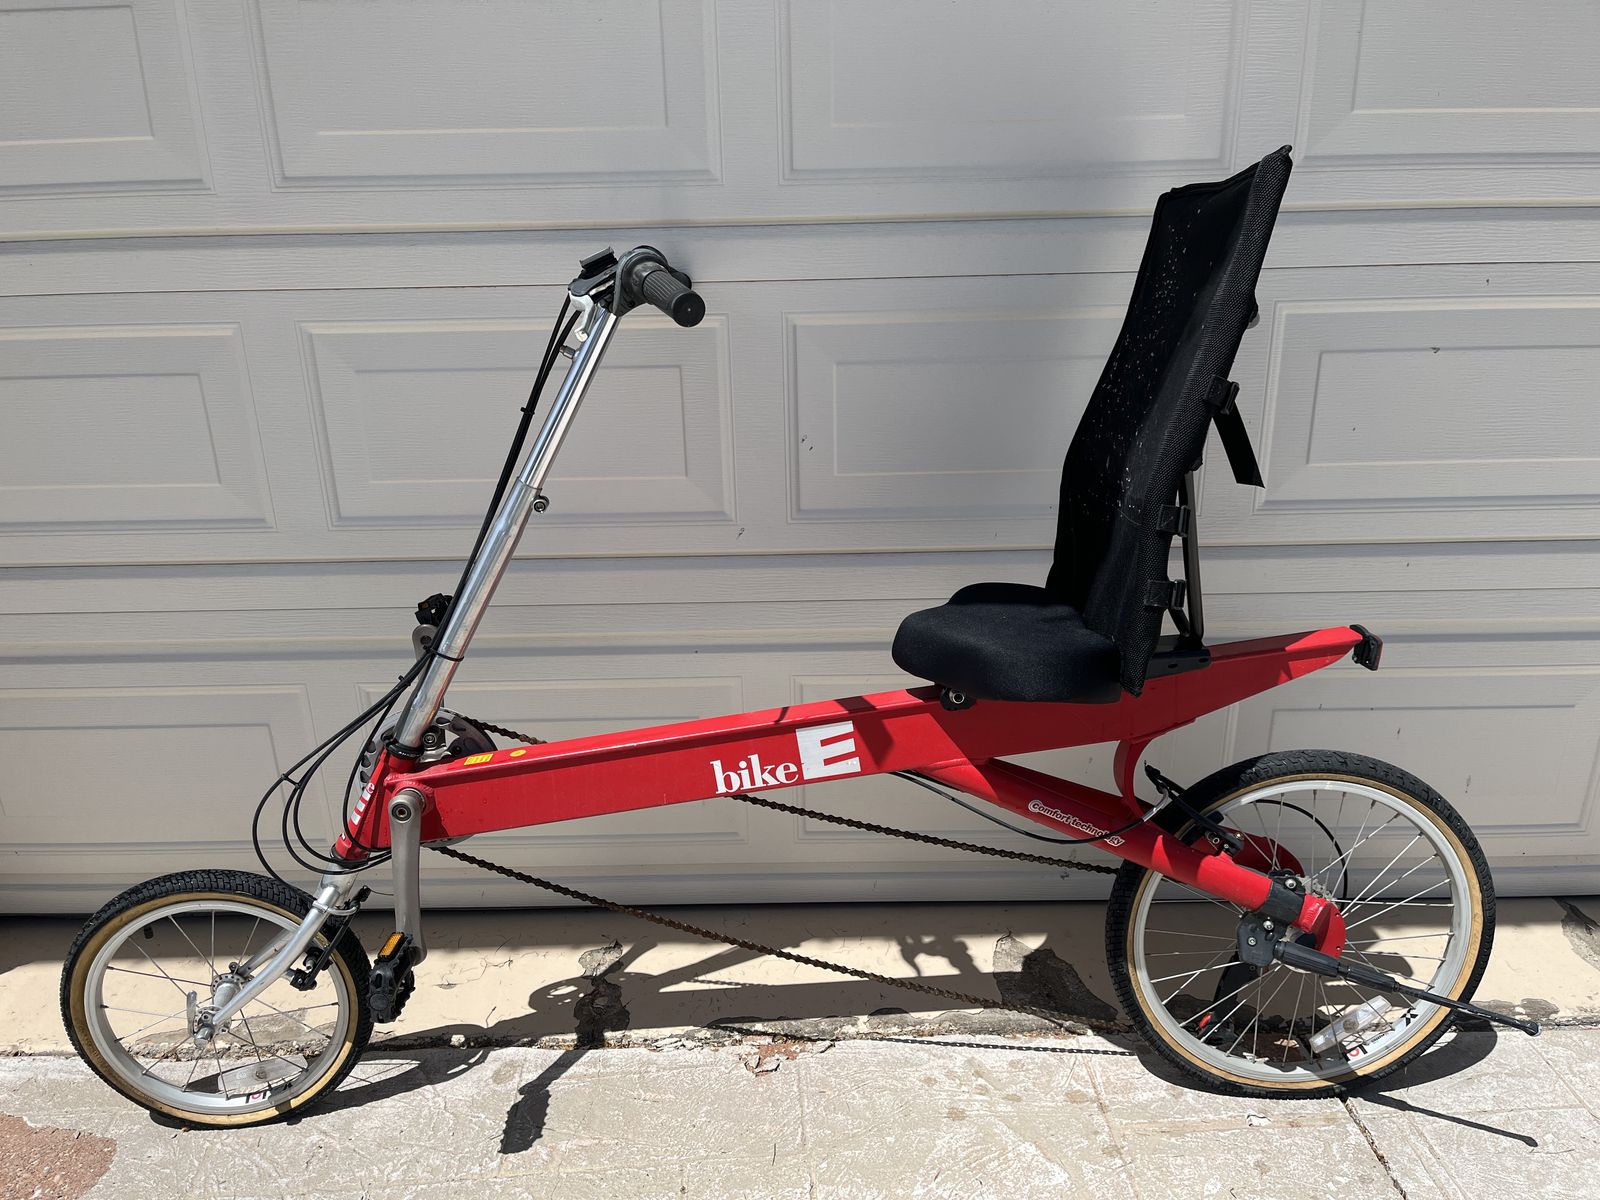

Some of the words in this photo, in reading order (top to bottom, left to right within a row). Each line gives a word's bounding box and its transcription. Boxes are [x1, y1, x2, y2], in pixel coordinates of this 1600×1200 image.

[710, 753, 799, 795] bike
[796, 720, 862, 780] E
[1028, 800, 1071, 825] Comfort
[1070, 817, 1125, 847] technolgy
